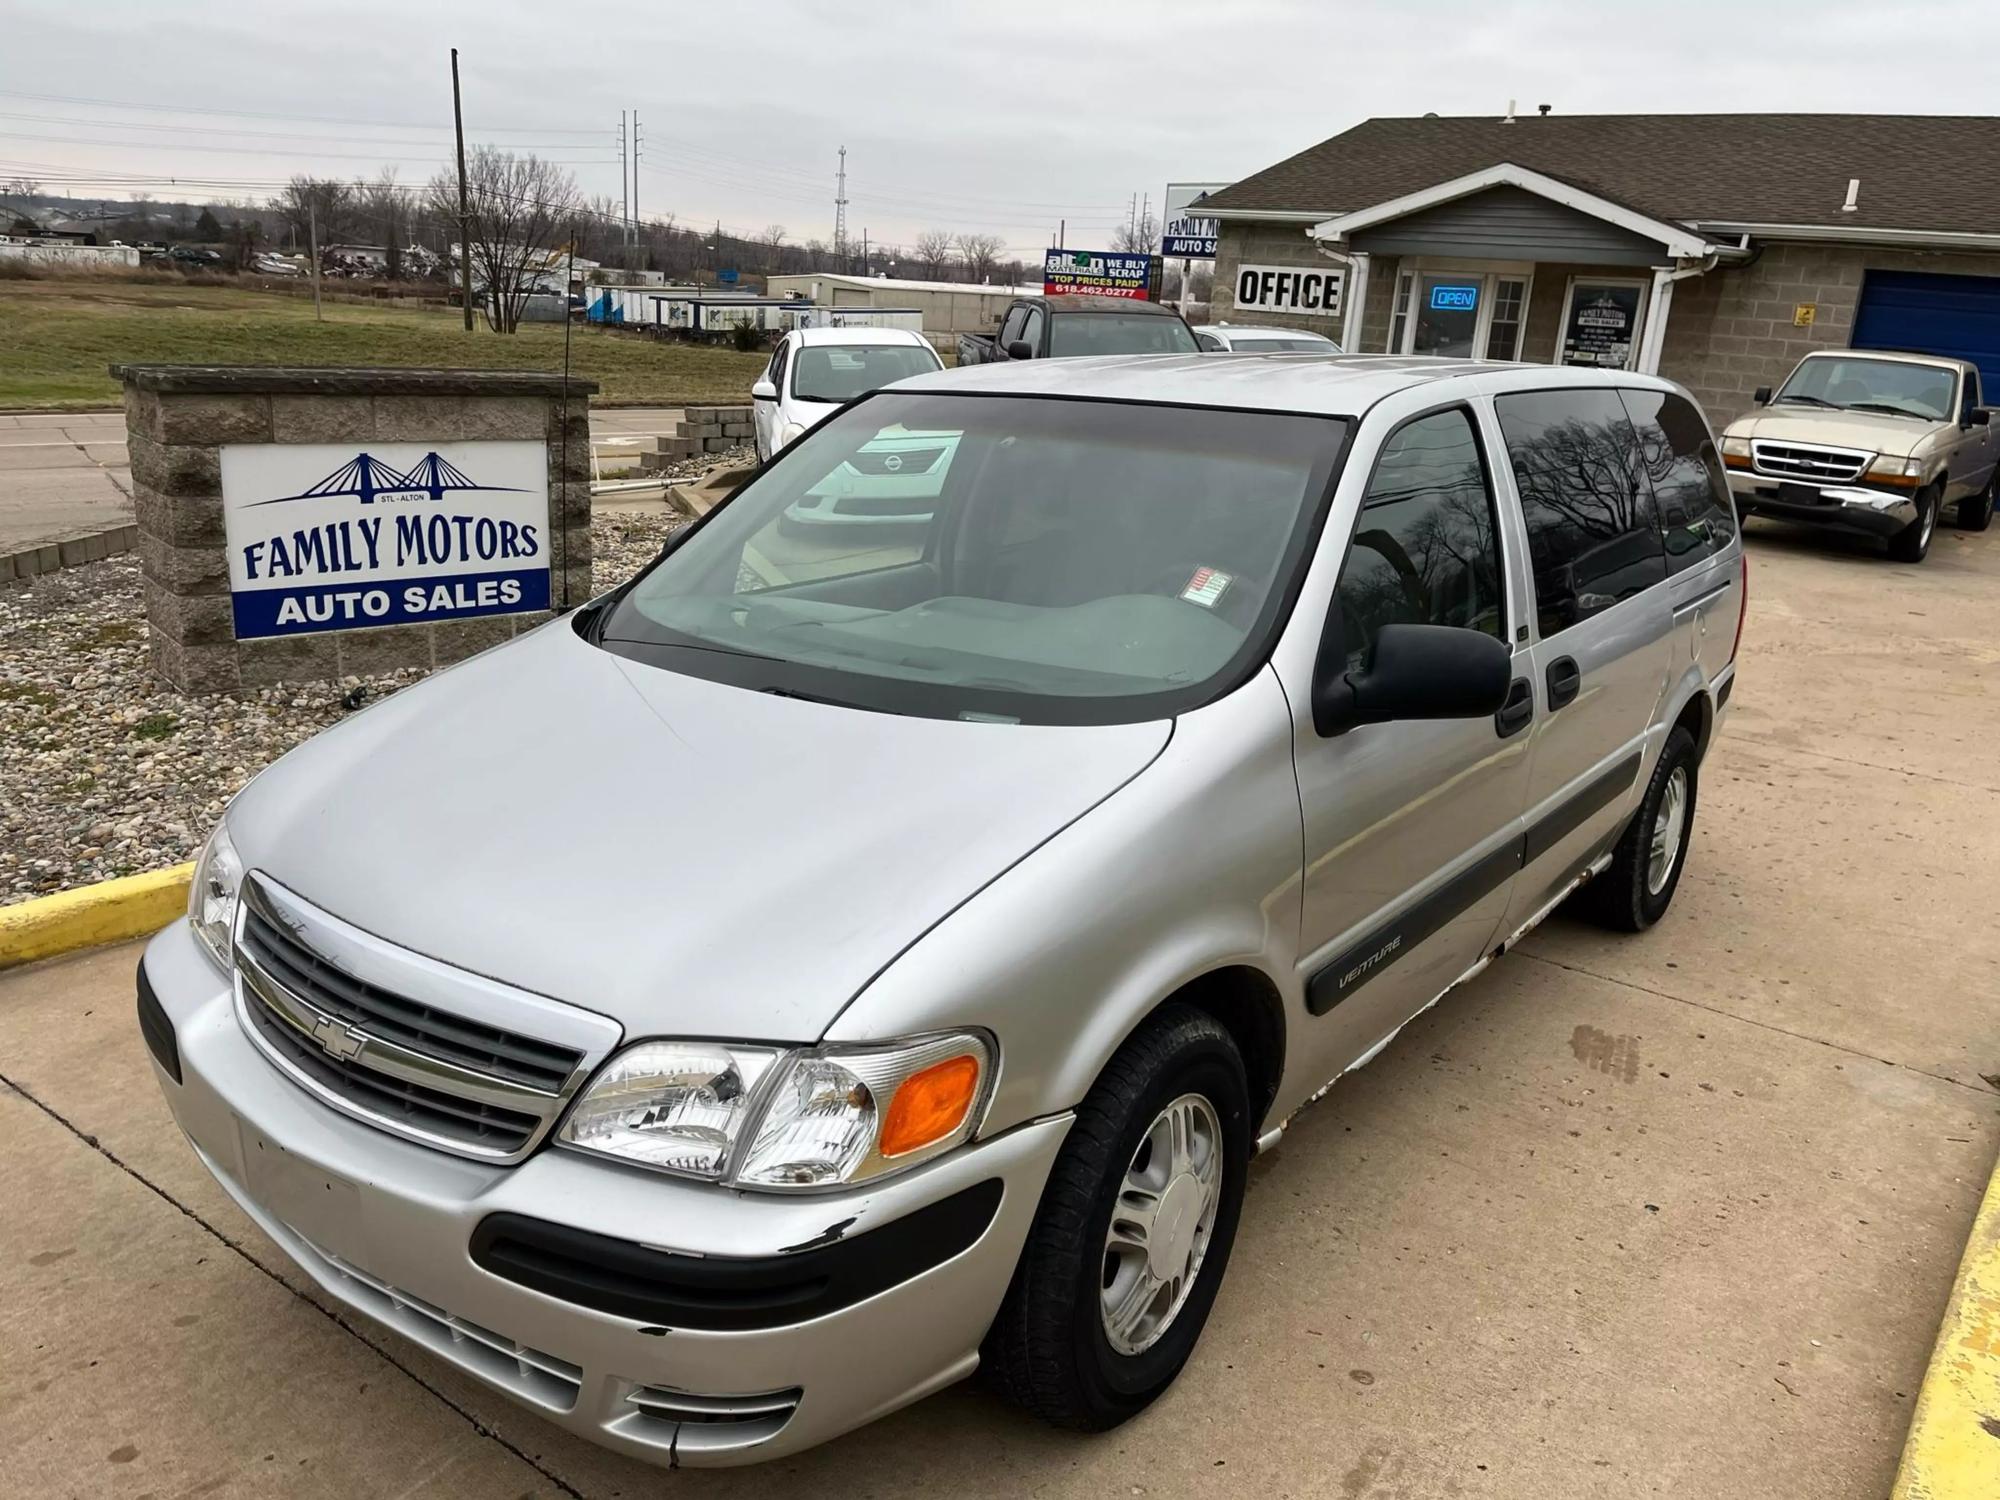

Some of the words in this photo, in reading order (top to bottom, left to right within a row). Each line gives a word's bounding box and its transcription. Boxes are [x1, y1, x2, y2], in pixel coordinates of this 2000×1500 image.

[1168, 217, 1204, 236] FAMILY
[1172, 239, 1202, 253] AUTO
[1046, 265, 1104, 276] MATERIALS
[1107, 258, 1123, 268] WE
[1125, 259, 1148, 270] BUY
[1109, 268, 1144, 279] SCRAP
[1076, 276, 1113, 287] PRICES
[1055, 284, 1136, 297] 618.462.0277
[1239, 270, 1340, 310] OFFICE
[1437, 292, 1472, 305] OPEN
[381, 495, 395, 503] STL
[401, 494, 424, 502] ALTON
[243, 516, 382, 580] FAMILY
[395, 513, 539, 567] MOTORS
[275, 589, 391, 625] AUTO
[403, 579, 522, 613] SALES
[1339, 935, 1402, 989] VENTURE
